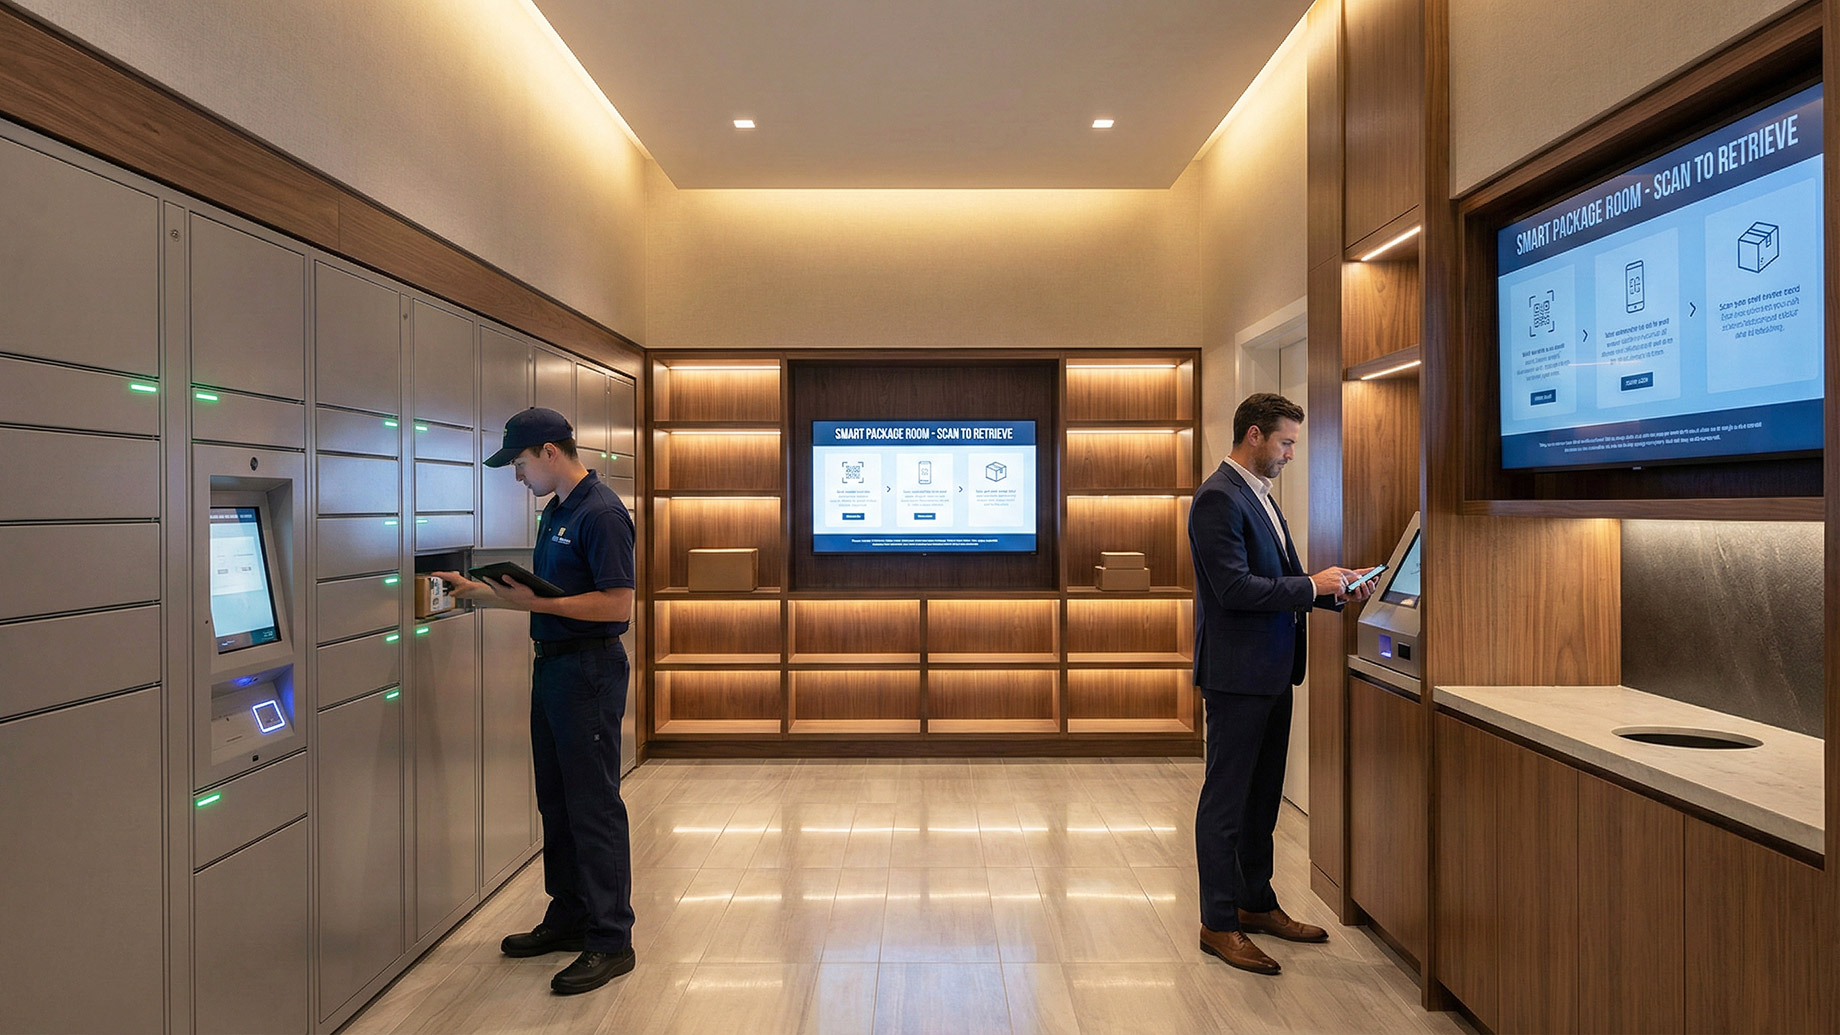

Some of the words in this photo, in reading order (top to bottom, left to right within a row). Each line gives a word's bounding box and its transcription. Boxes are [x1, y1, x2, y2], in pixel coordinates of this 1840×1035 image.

[1516, 221, 1551, 256] SMART
[1552, 199, 1603, 242] PACKAGE
[1605, 181, 1642, 221] ROOM
[1653, 160, 1691, 200] SCAN
[1694, 151, 1714, 183] TO
[1718, 113, 1799, 175] RETRIEVE
[835, 427, 864, 440] SMART
[866, 427, 904, 440] PACKAGE
[905, 427, 930, 440] ROOM
[936, 427, 960, 440] SCAN
[961, 427, 972, 440] TO
[973, 427, 1013, 440] RETRIEVE
